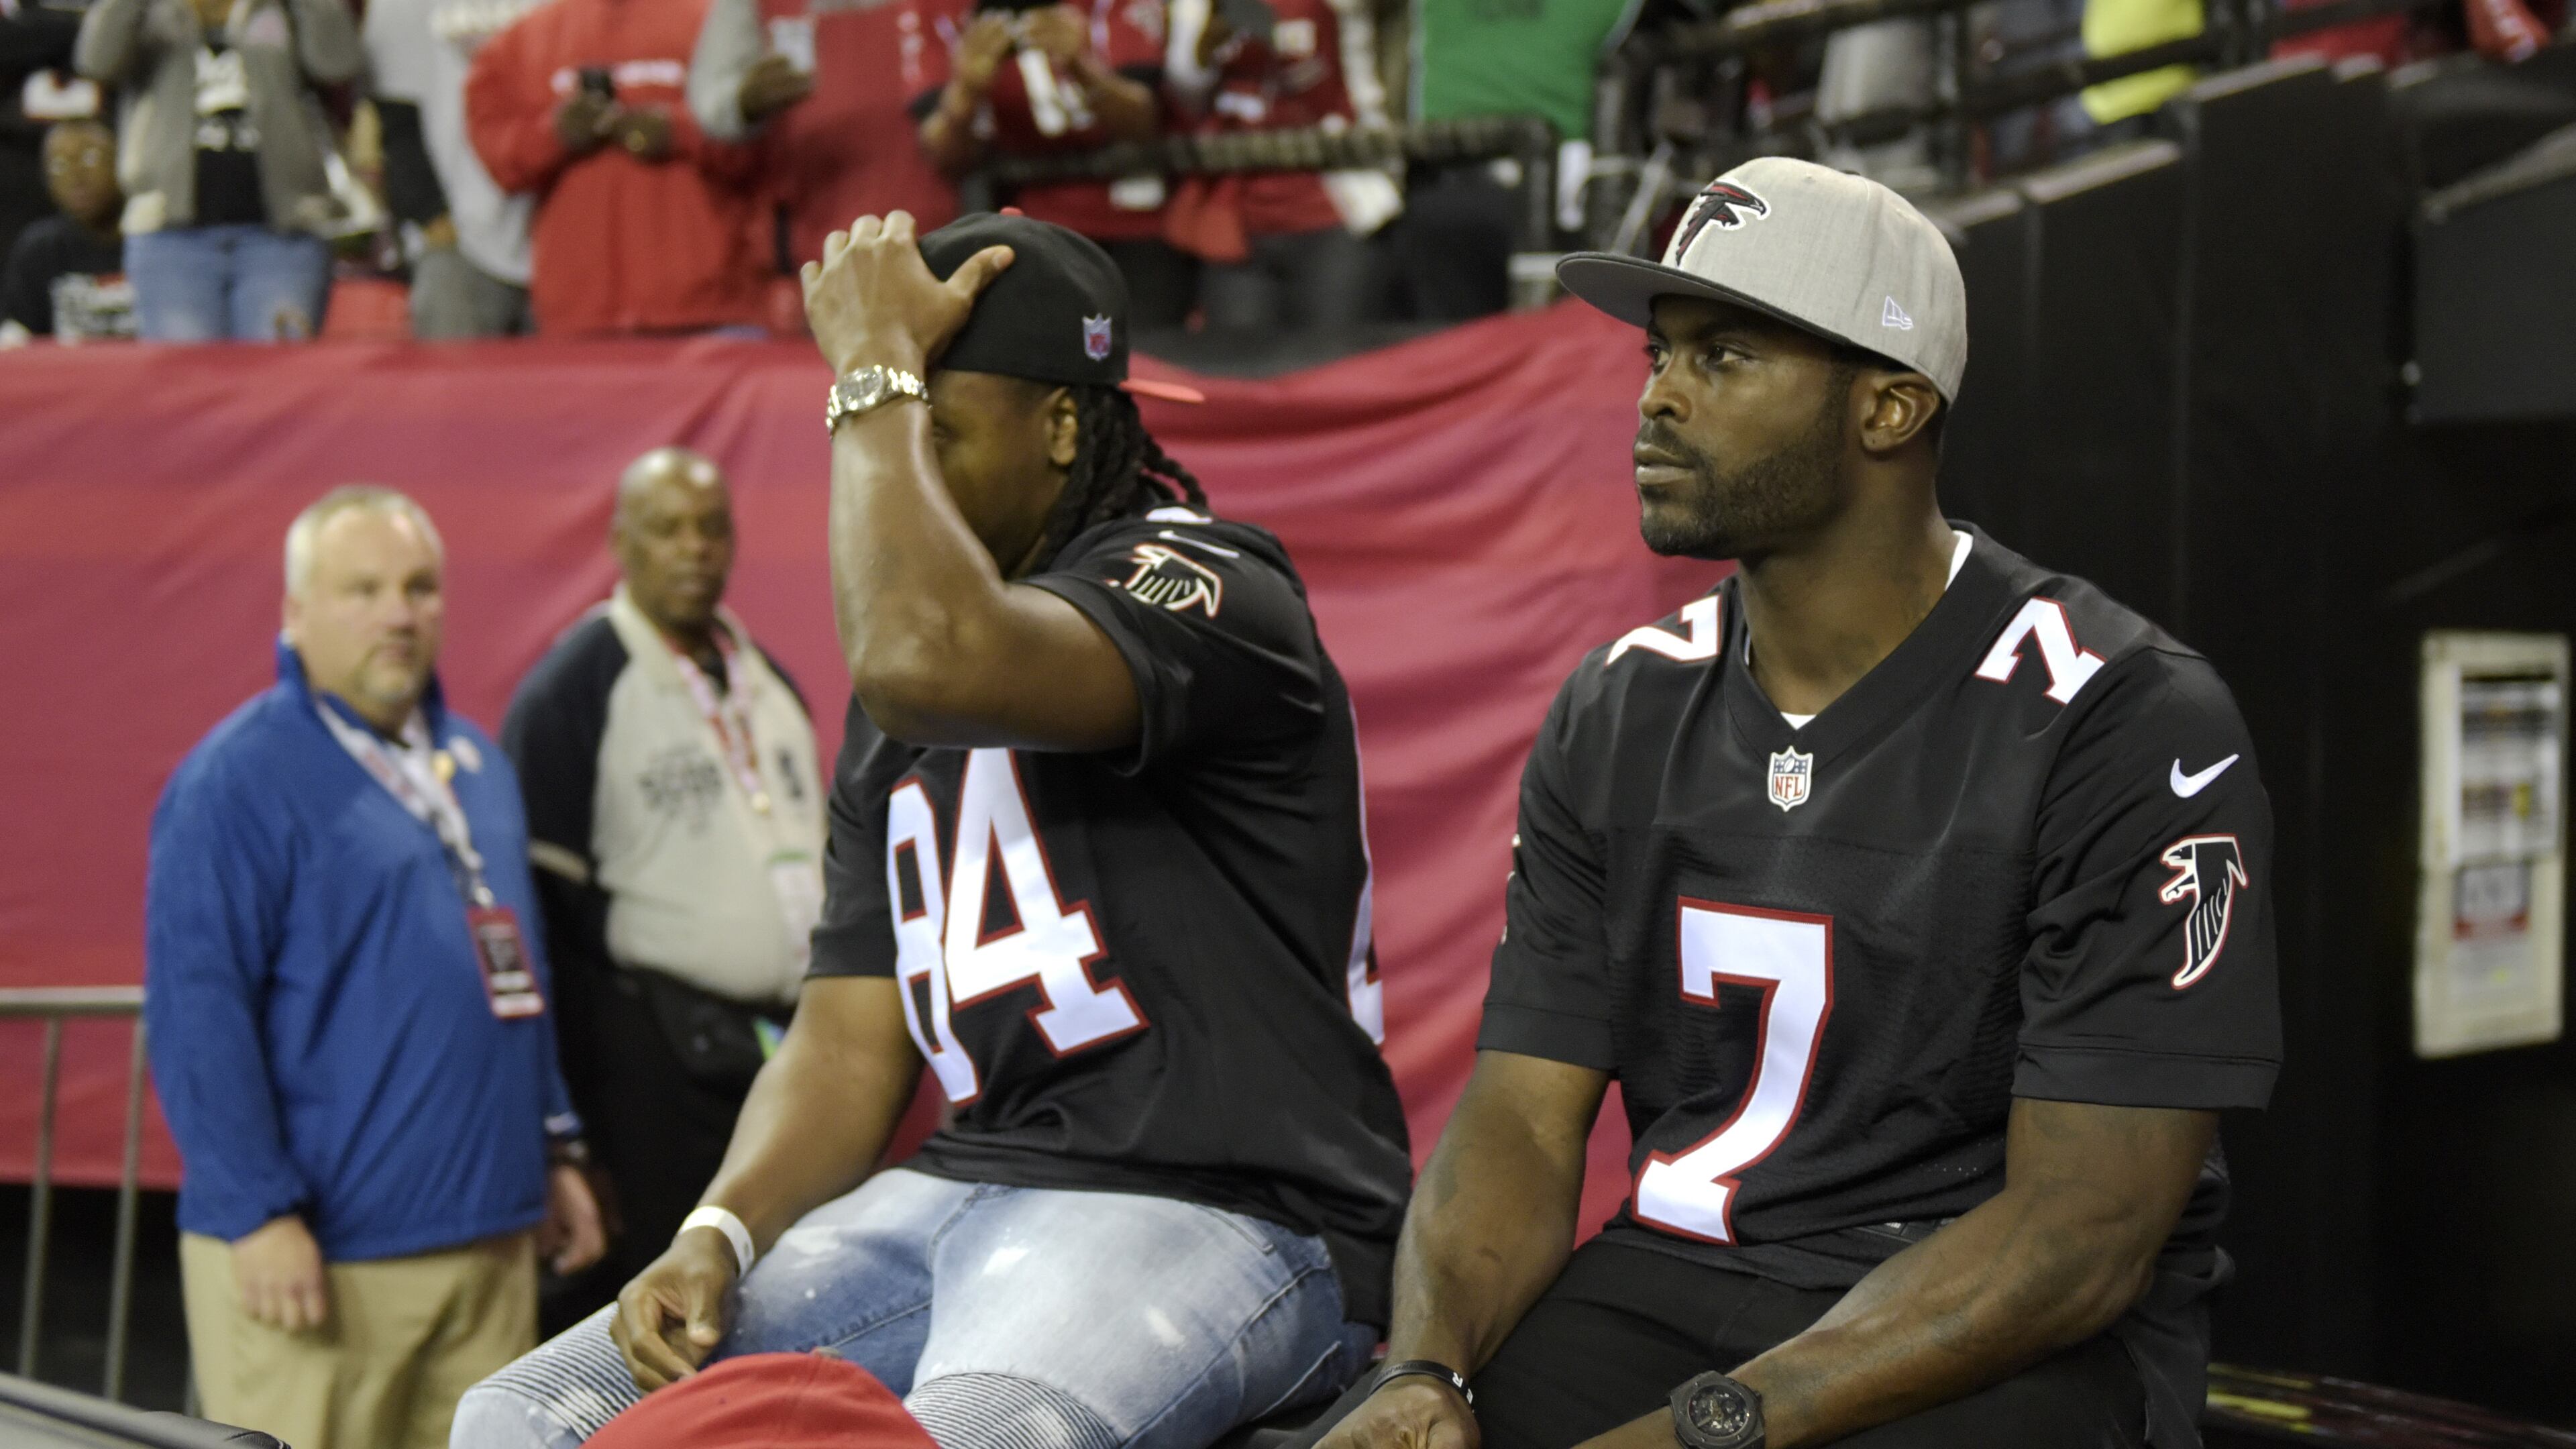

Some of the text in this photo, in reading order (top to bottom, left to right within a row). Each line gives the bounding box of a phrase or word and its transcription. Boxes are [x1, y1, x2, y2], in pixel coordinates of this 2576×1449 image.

[1974, 595, 2107, 706] 7
[1774, 775, 1803, 800] NFL
[886, 747, 1151, 1108] 84
[1631, 895, 1833, 1247] 7
